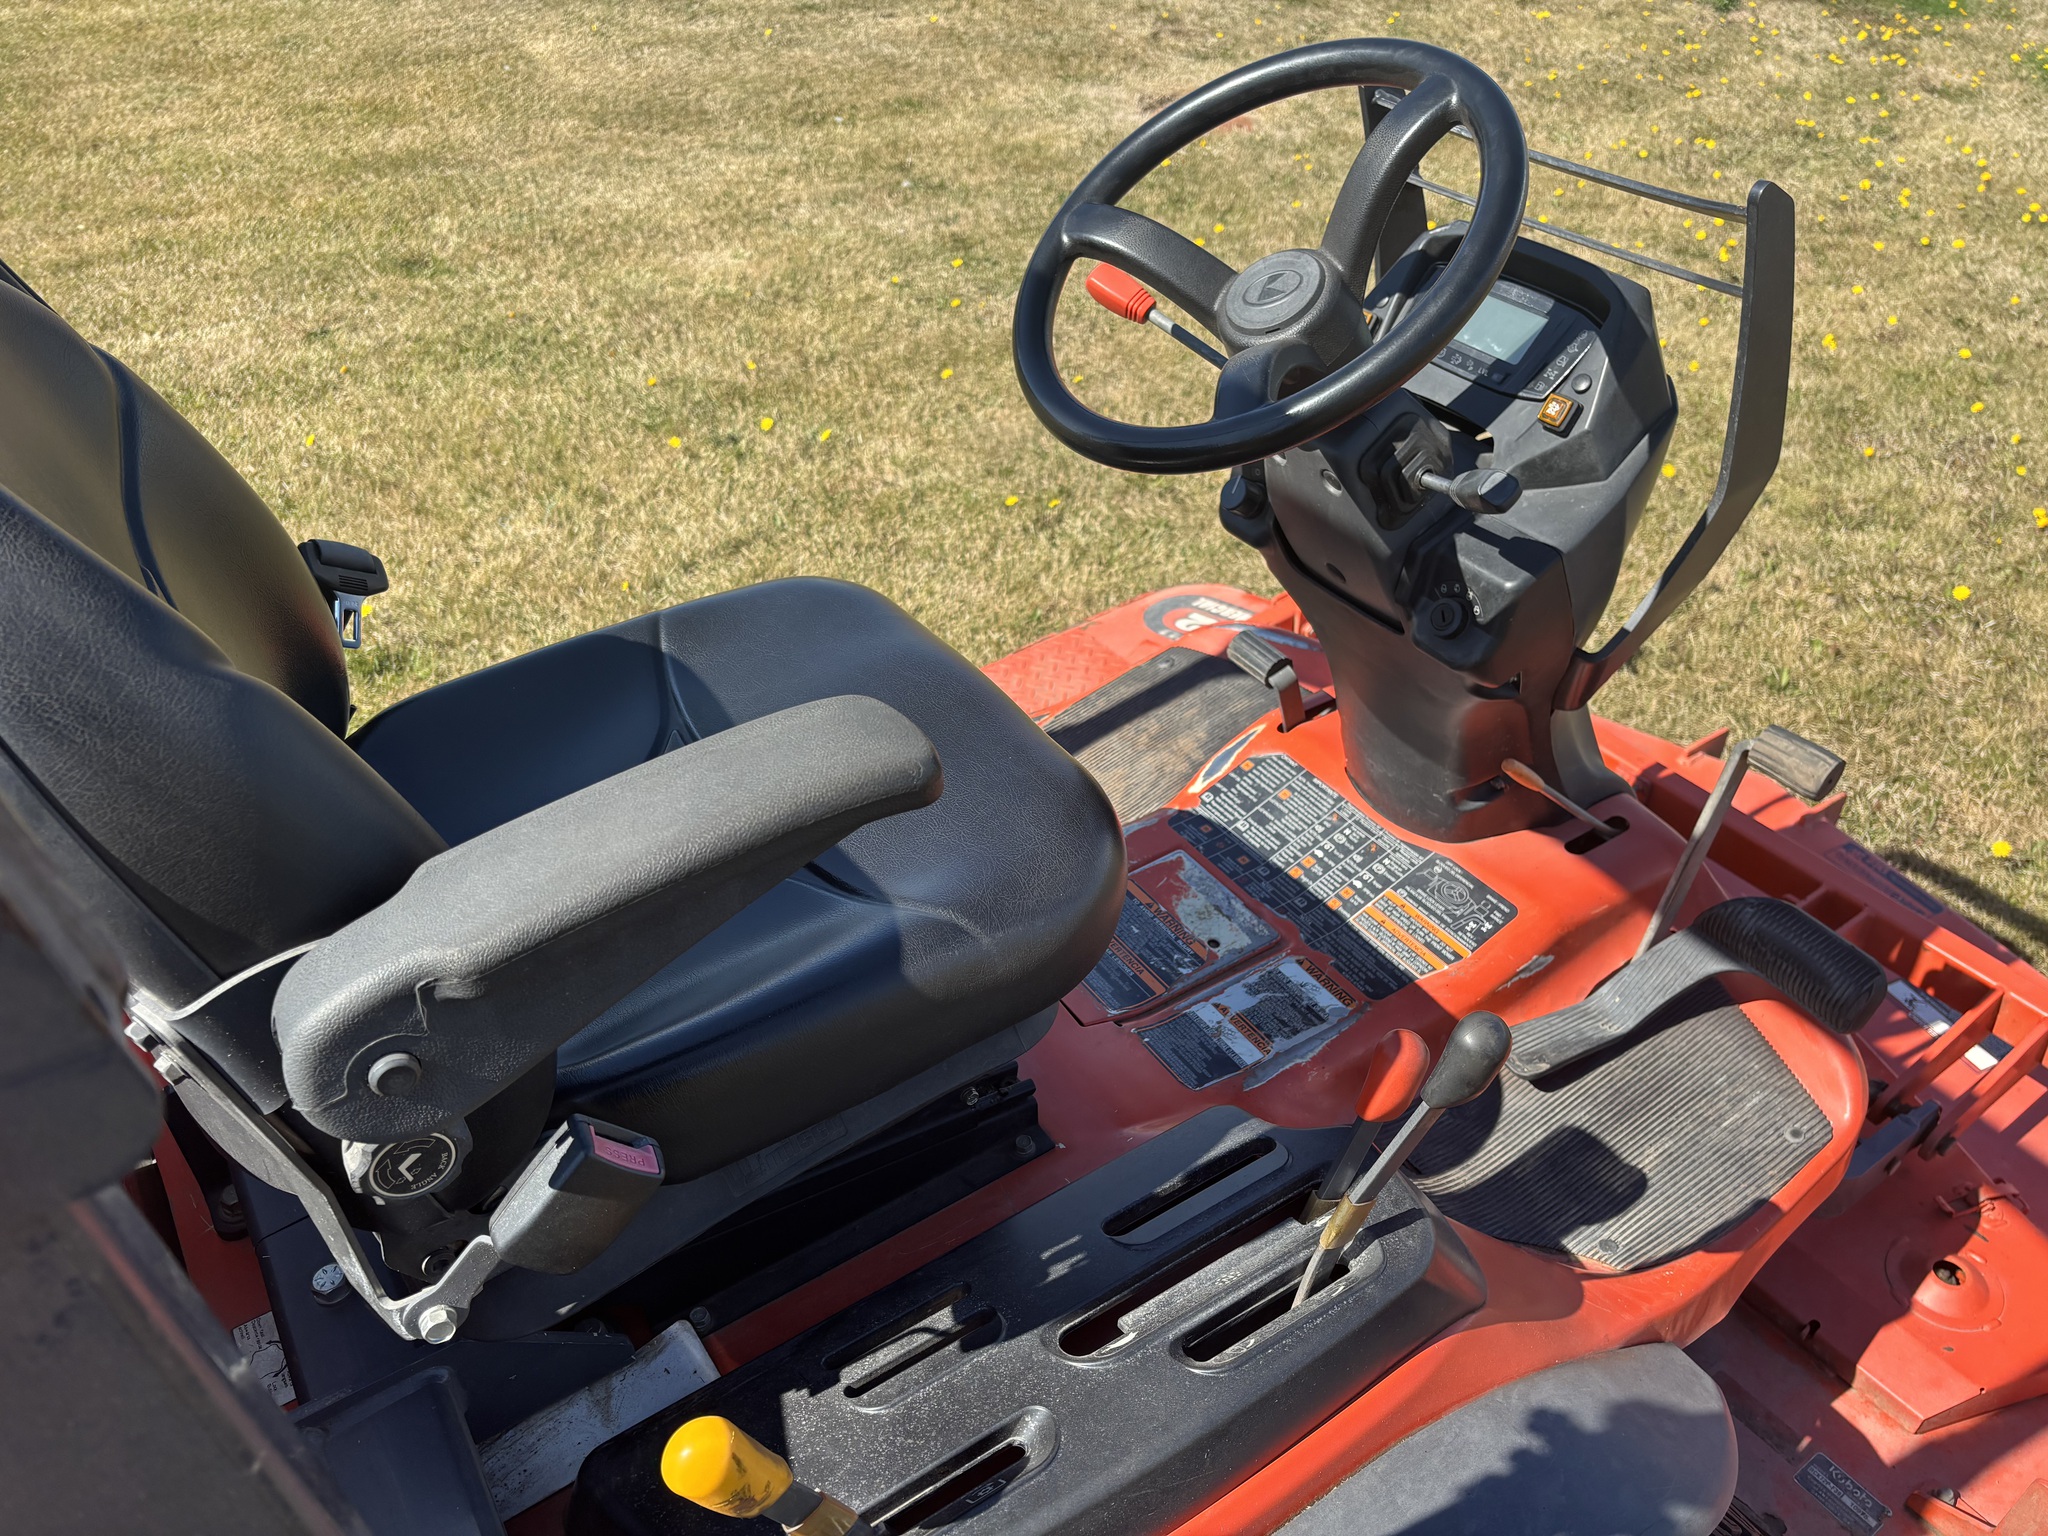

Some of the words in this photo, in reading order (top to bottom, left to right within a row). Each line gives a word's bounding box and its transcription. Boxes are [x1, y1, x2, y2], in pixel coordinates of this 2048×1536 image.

[1153, 907, 1195, 947] WARNING
[1153, 917, 1177, 940] PERSONAL
[1177, 939, 1195, 956] INJURY
[1413, 912, 1441, 935] WARNING
[1305, 964, 1355, 1008] WARNING
[438, 1151, 449, 1171] BACK
[604, 1143, 647, 1169] PRESS
[410, 1171, 438, 1191] ANGLE
[1828, 1465, 1873, 1508] Kubota
